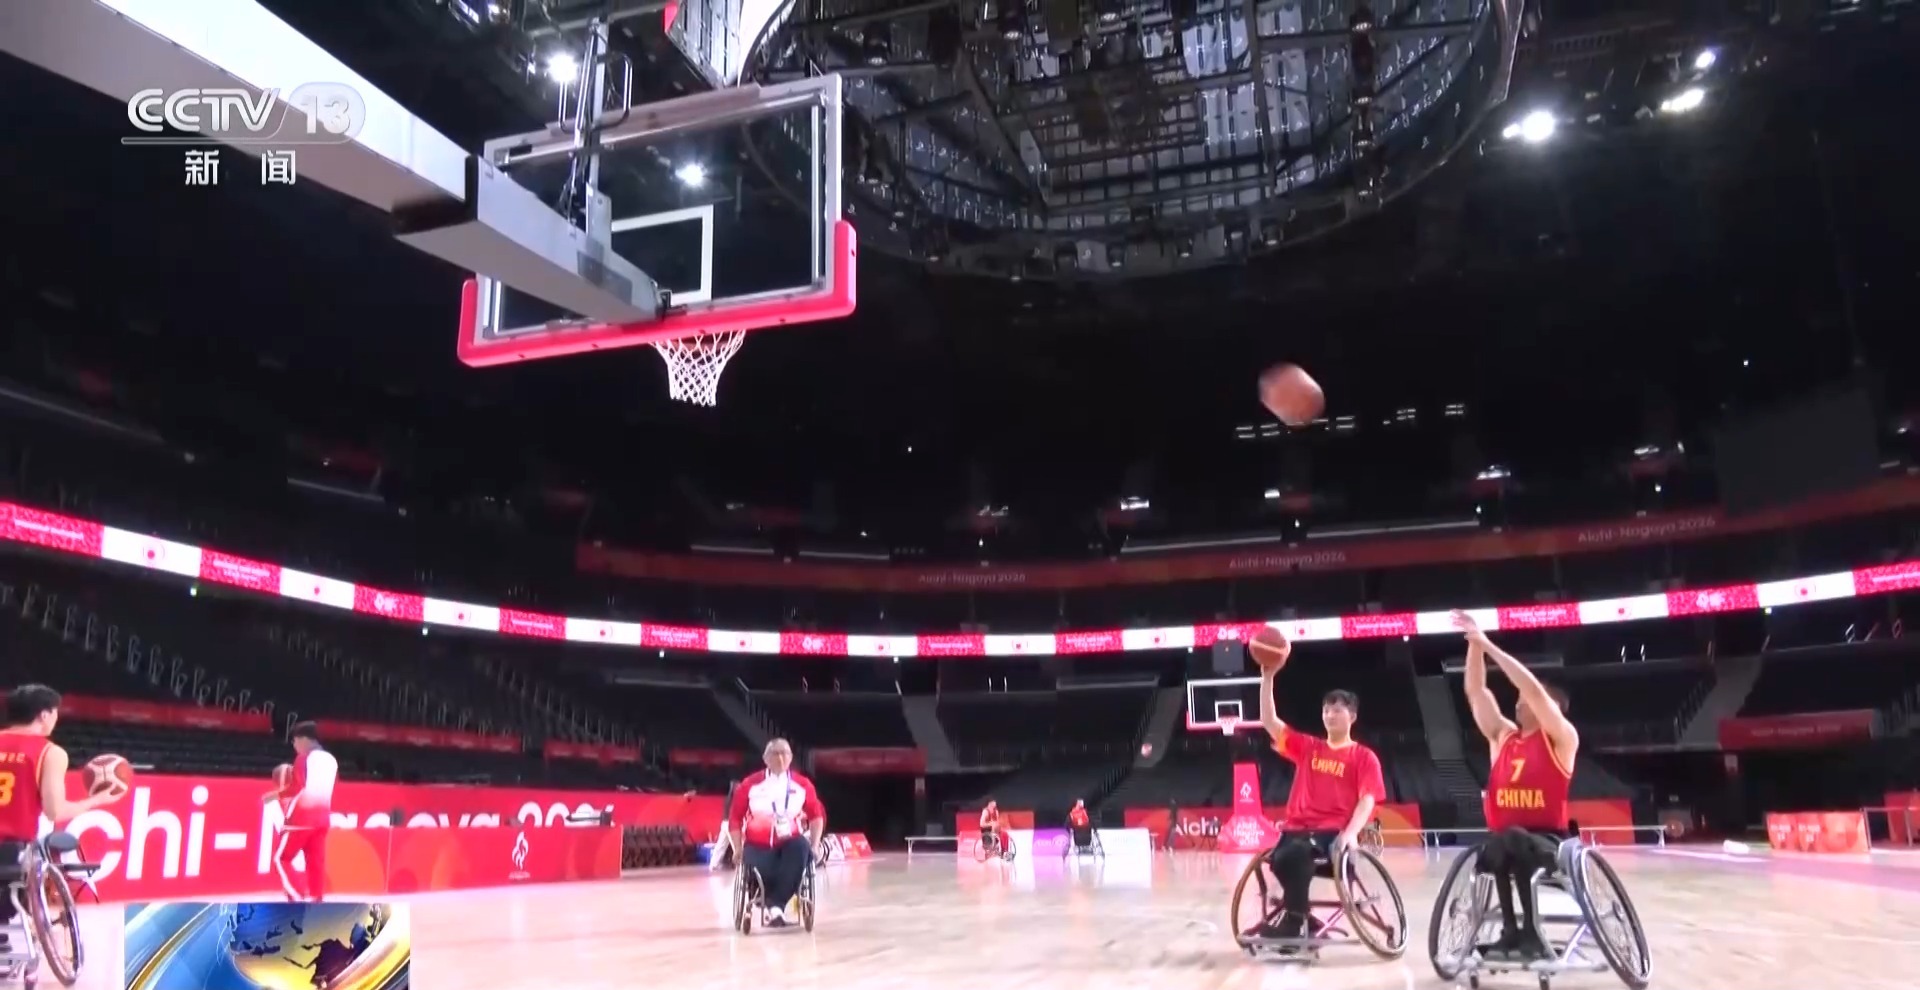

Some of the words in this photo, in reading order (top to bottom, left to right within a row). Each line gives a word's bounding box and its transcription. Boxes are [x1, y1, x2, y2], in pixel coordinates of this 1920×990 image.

[1311, 757, 1345, 777] CHINA
[1510, 759, 1525, 782] 7
[1496, 789, 1545, 808] CHINA
